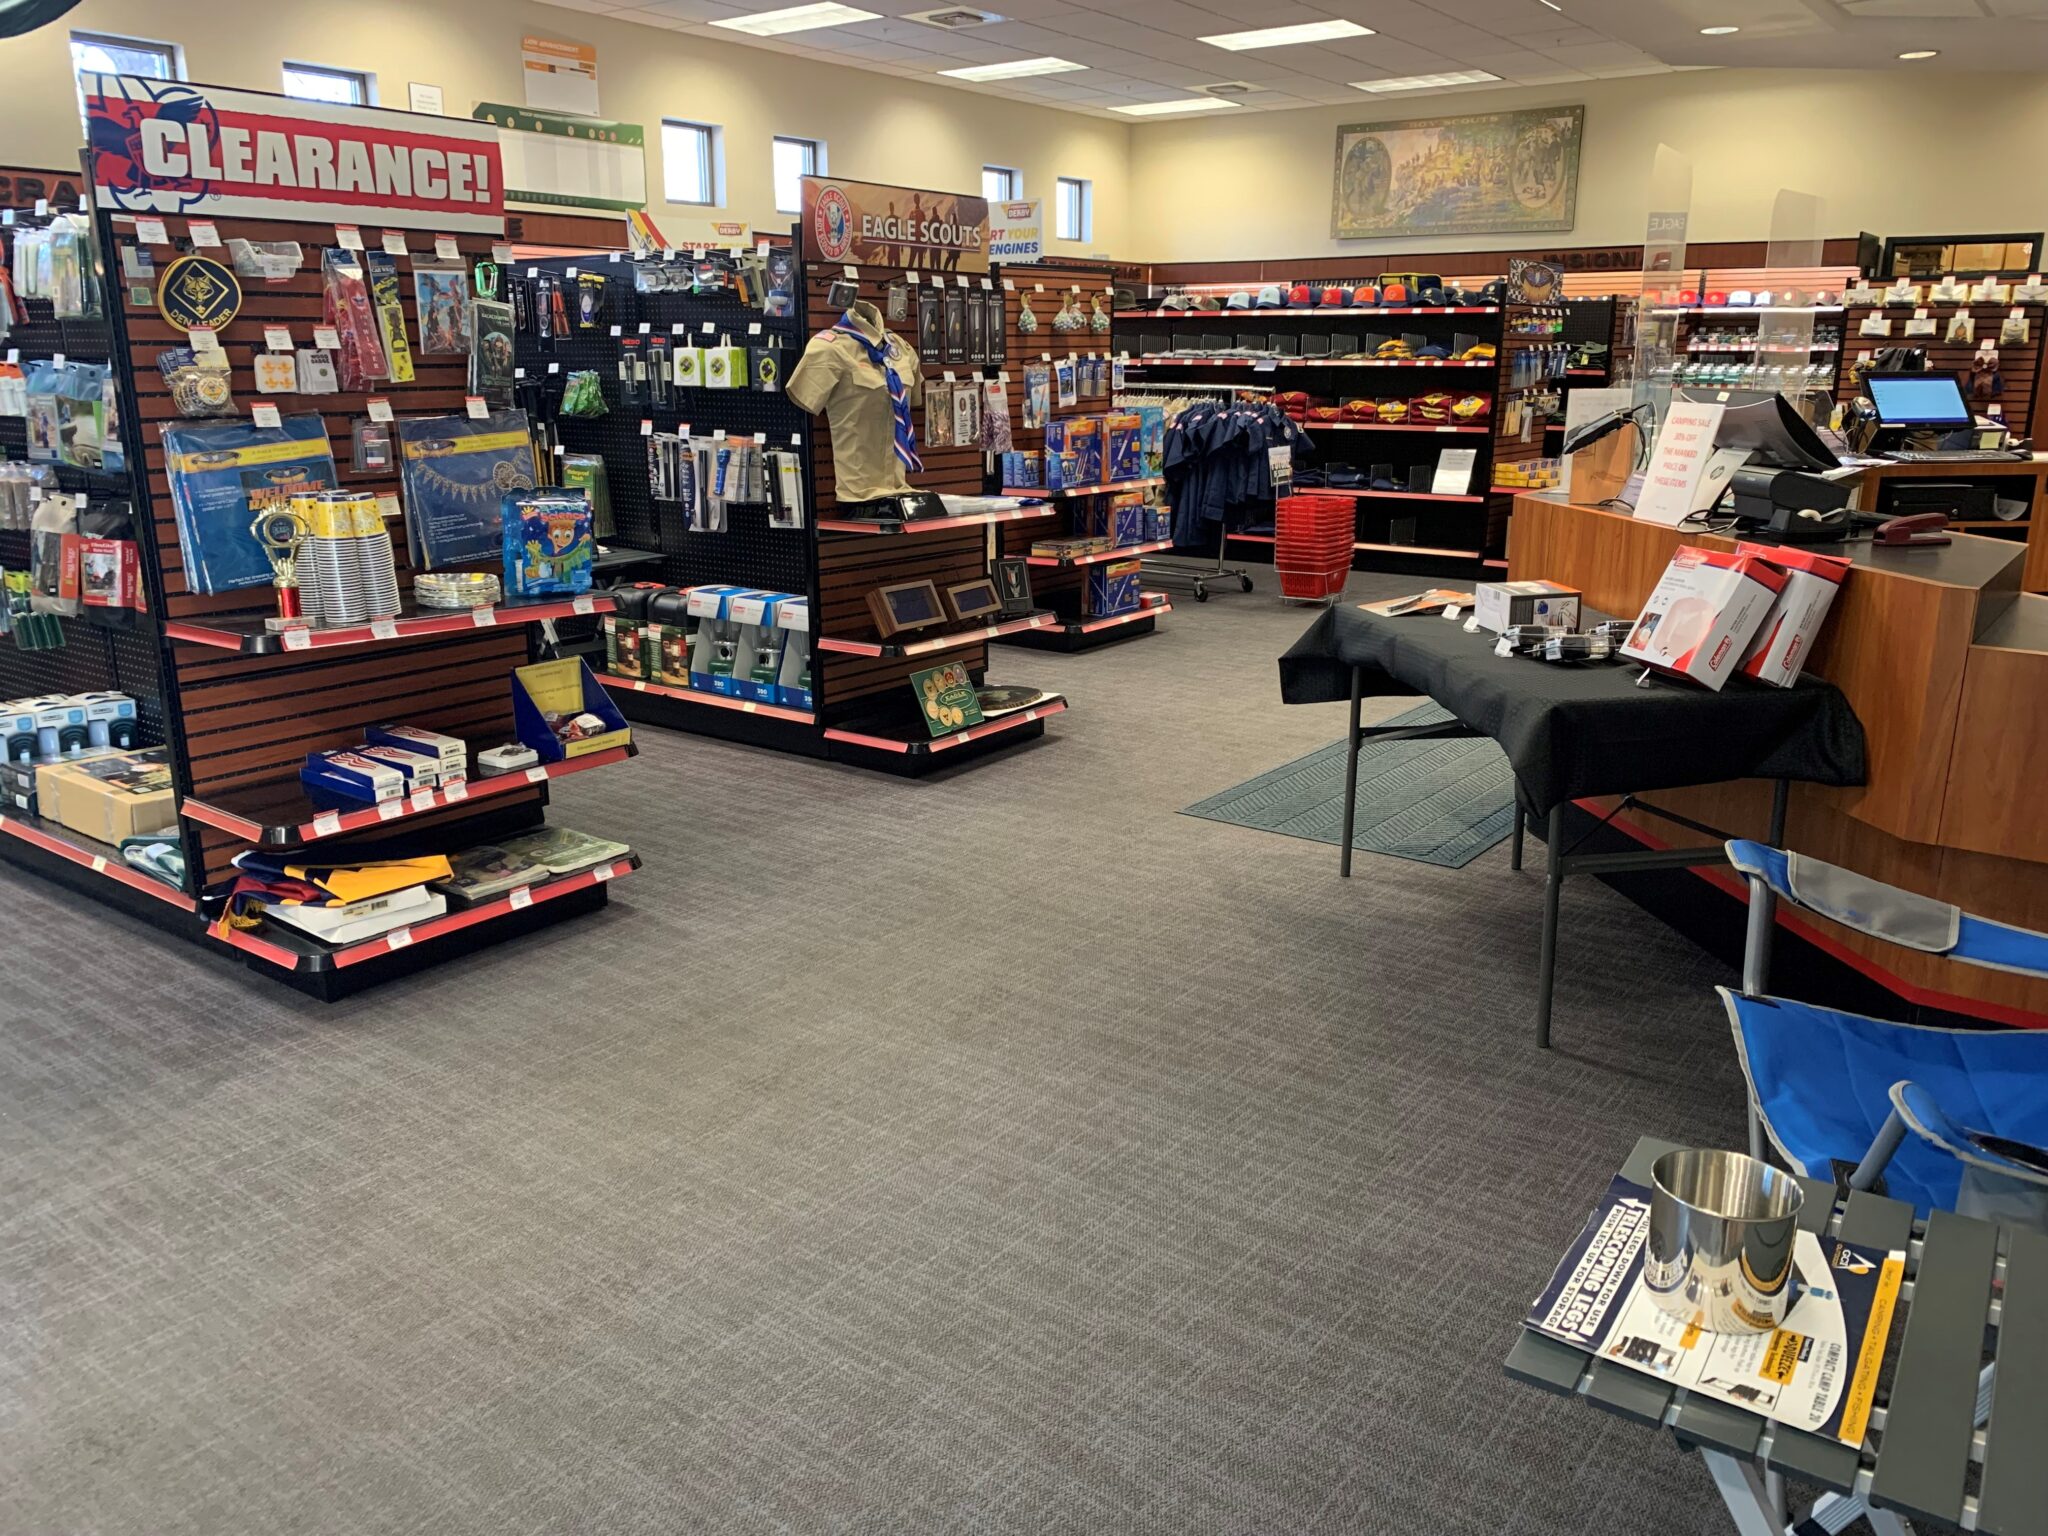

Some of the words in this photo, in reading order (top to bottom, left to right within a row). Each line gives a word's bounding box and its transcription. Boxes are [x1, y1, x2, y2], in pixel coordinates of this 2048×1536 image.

[1443, 116, 1499, 125] SCOUTS
[140, 117, 491, 204] CLEARANCE!
[862, 214, 917, 242] EAGLE
[919, 220, 981, 248] SCOUTS
[1008, 227, 1039, 241] YOUR
[988, 240, 1040, 256] ENGINES
[1542, 250, 1645, 270] INSIGNI
[170, 308, 193, 327] DEN
[197, 307, 234, 327] LEADER
[1671, 416, 1697, 426] CAMPING
[1697, 418, 1712, 428] SALE
[1710, 638, 1730, 670] Coleman
[1783, 638, 1800, 670] Coleman
[1604, 1208, 1622, 1228] PUSH
[1634, 1215, 1650, 1235] PULL
[1583, 1207, 1643, 1292] TELESCOPING
[1594, 1229, 1608, 1250] LEGS
[1626, 1236, 1641, 1255] LEGS
[1585, 1252, 1596, 1264] UP
[1572, 1265, 1588, 1283] FOR
[1609, 1257, 1629, 1285] DOWN
[1548, 1286, 1576, 1328] STORAGE
[1599, 1288, 1613, 1306] FOR
[1561, 1293, 1594, 1332] LEGS
[1588, 1309, 1602, 1328] USE
[1874, 1299, 1888, 1335] CAMPING
[1824, 1343, 1841, 1372] COMPACT
[1861, 1340, 1878, 1390] TAILGATING
[1818, 1371, 1833, 1392] CAMP
[1811, 1391, 1827, 1413] TABLE
[1846, 1397, 1863, 1435] FISHING
